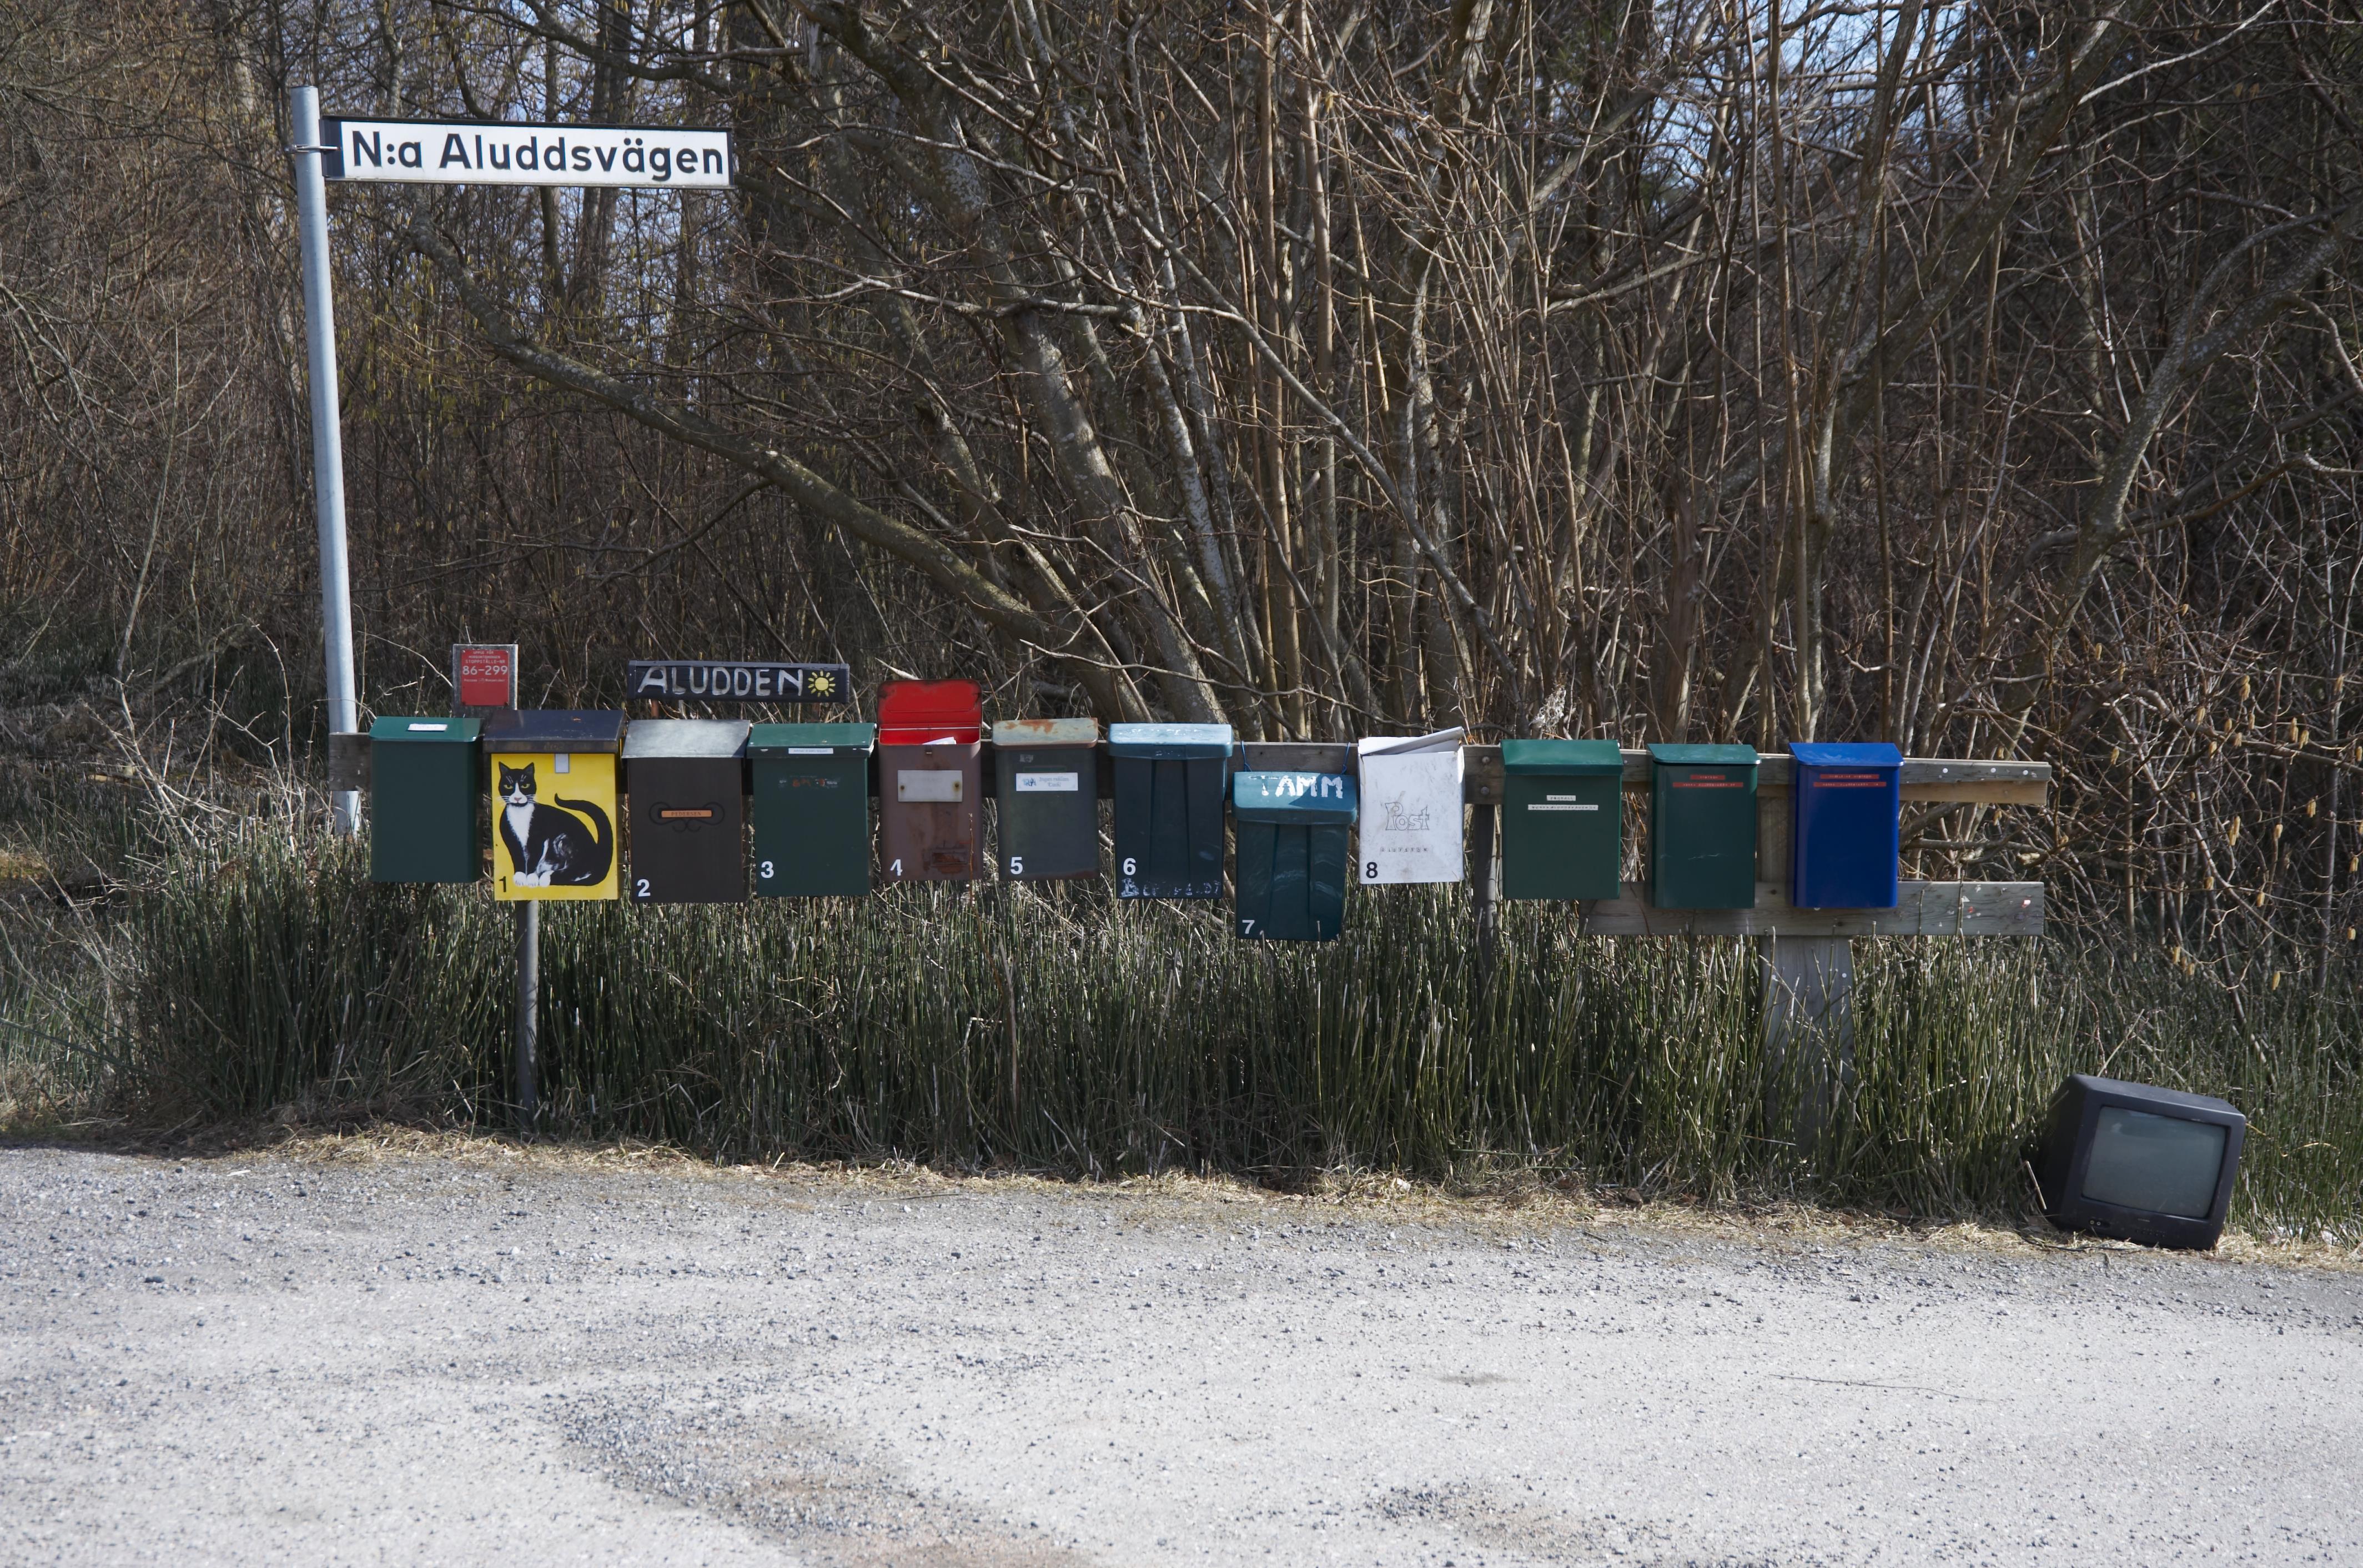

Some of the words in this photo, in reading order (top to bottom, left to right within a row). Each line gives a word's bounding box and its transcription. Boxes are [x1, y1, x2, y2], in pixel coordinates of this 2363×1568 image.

[352, 130, 423, 168] N:a
[439, 133, 723, 181] Aluddsvägen
[462, 665, 508, 675] 86-299
[638, 666, 803, 696] ALUDDEN
[1248, 775, 1344, 799] TAMM
[1385, 802, 1430, 831] Post
[761, 861, 774, 878] 3
[1010, 856, 1023, 875] 5
[1123, 857, 1136, 876] 6
[1366, 862, 1378, 878] 8
[499, 876, 507, 893] 1
[637, 879, 651, 897] 2
[1242, 919, 1255, 934] 7
